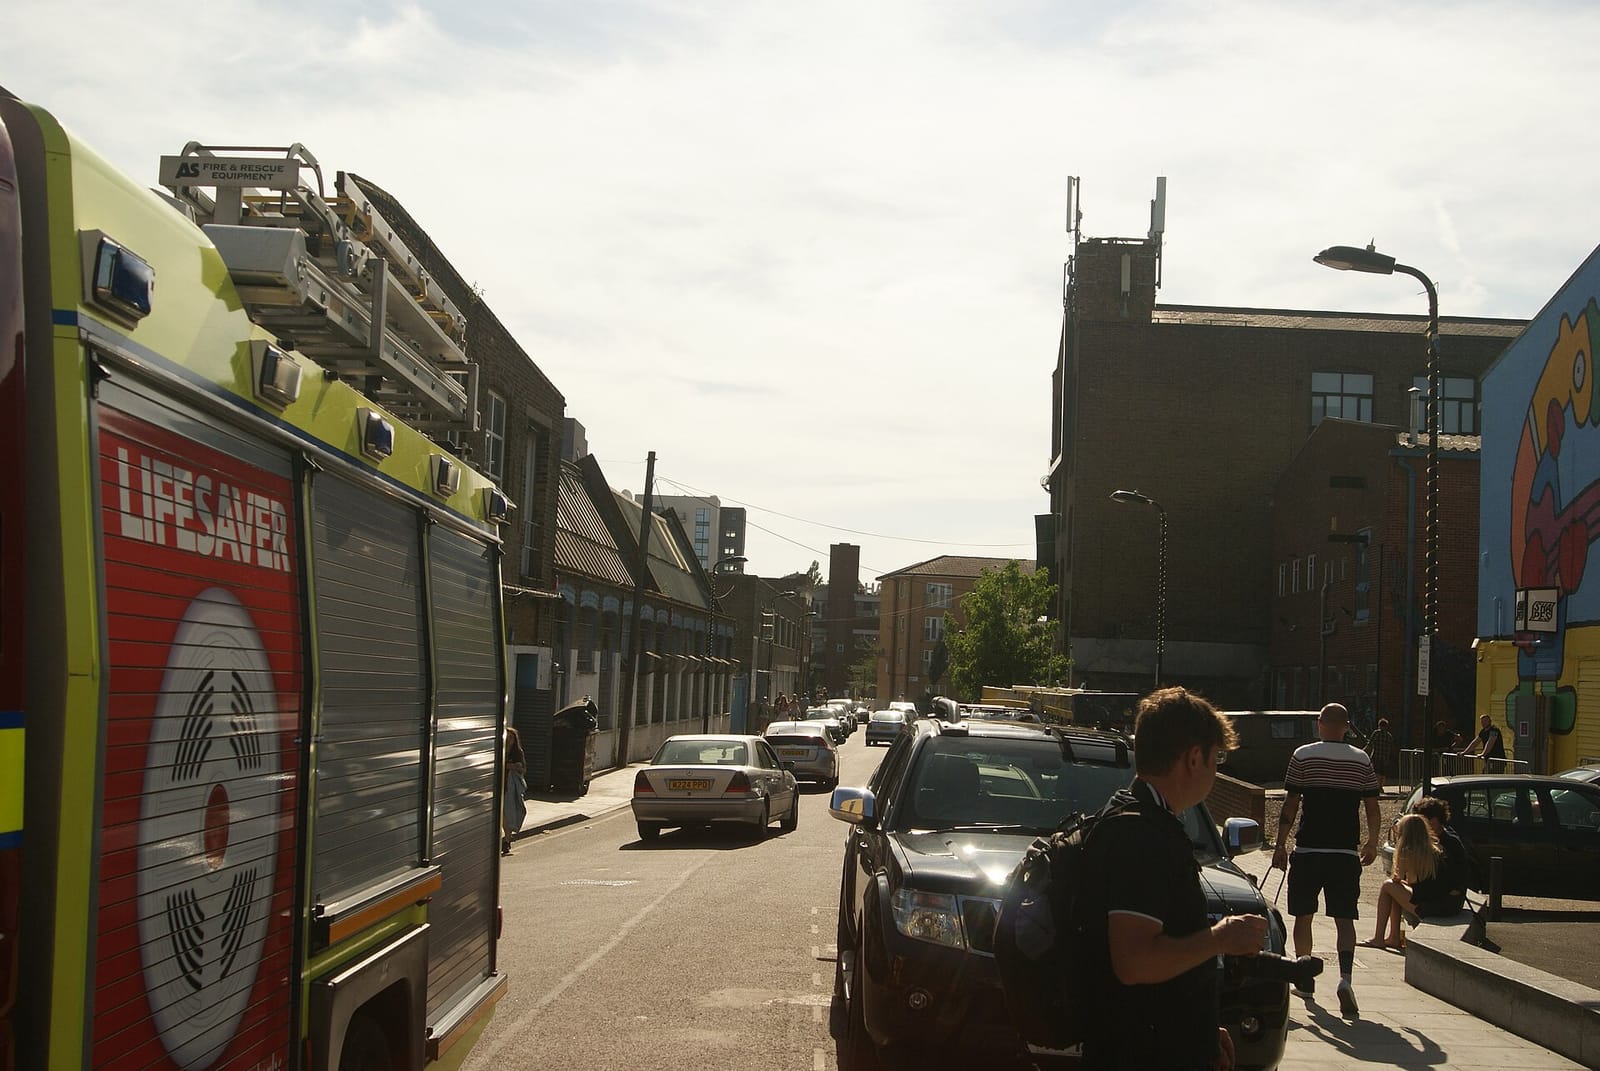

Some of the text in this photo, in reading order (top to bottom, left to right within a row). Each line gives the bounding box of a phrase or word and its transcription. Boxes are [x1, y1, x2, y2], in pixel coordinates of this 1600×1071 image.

[175, 162, 200, 179] AS
[203, 163, 228, 171] FIRE
[240, 164, 285, 172] RESCUE
[211, 172, 274, 181] EQUIPMENT
[117, 447, 291, 572] LIFESAVER
